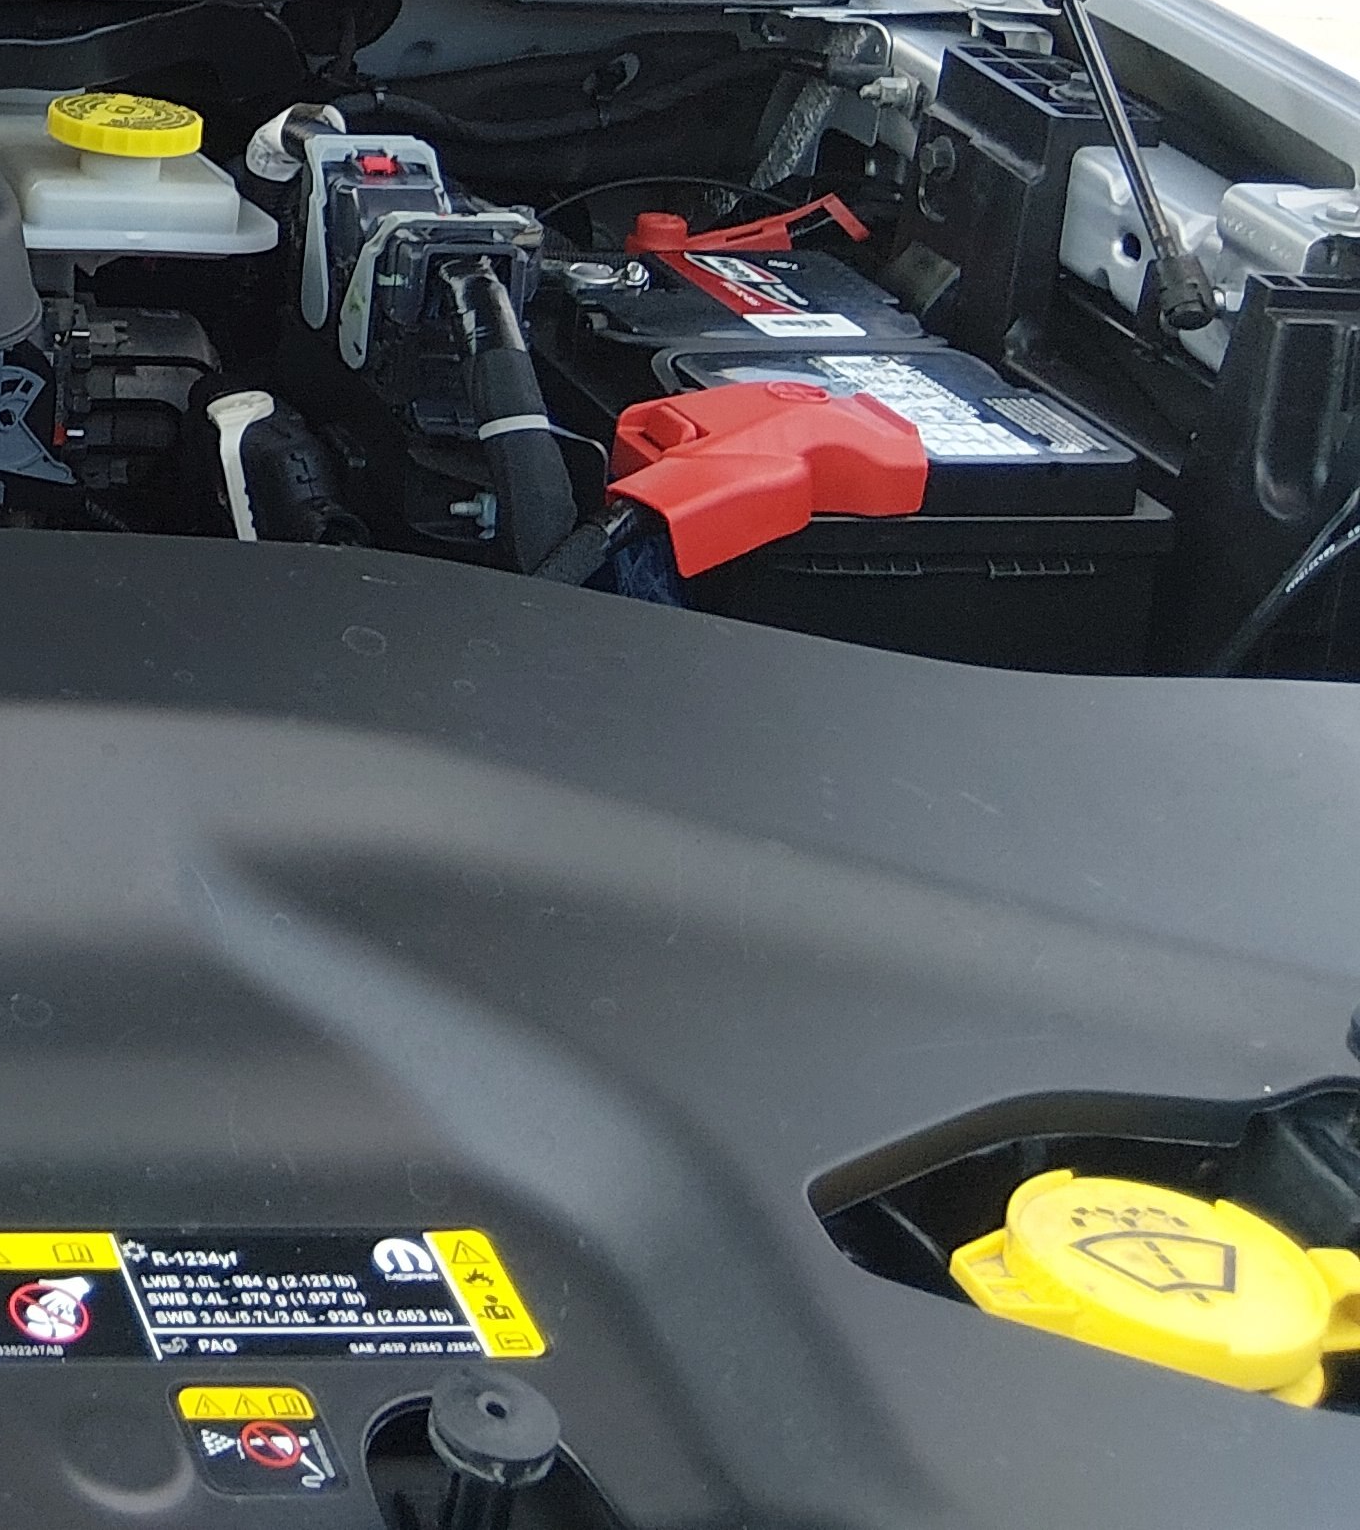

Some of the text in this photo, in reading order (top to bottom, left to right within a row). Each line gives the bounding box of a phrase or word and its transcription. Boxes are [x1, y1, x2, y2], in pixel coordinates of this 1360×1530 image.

[183, 1274, 220, 1289] 3.0L
[266, 1276, 279, 1290] g
[333, 1273, 358, 1289] lb)
[275, 1293, 288, 1308] g
[341, 1290, 367, 1307] lb)
[362, 1311, 375, 1325] g
[429, 1308, 454, 1325] lb)
